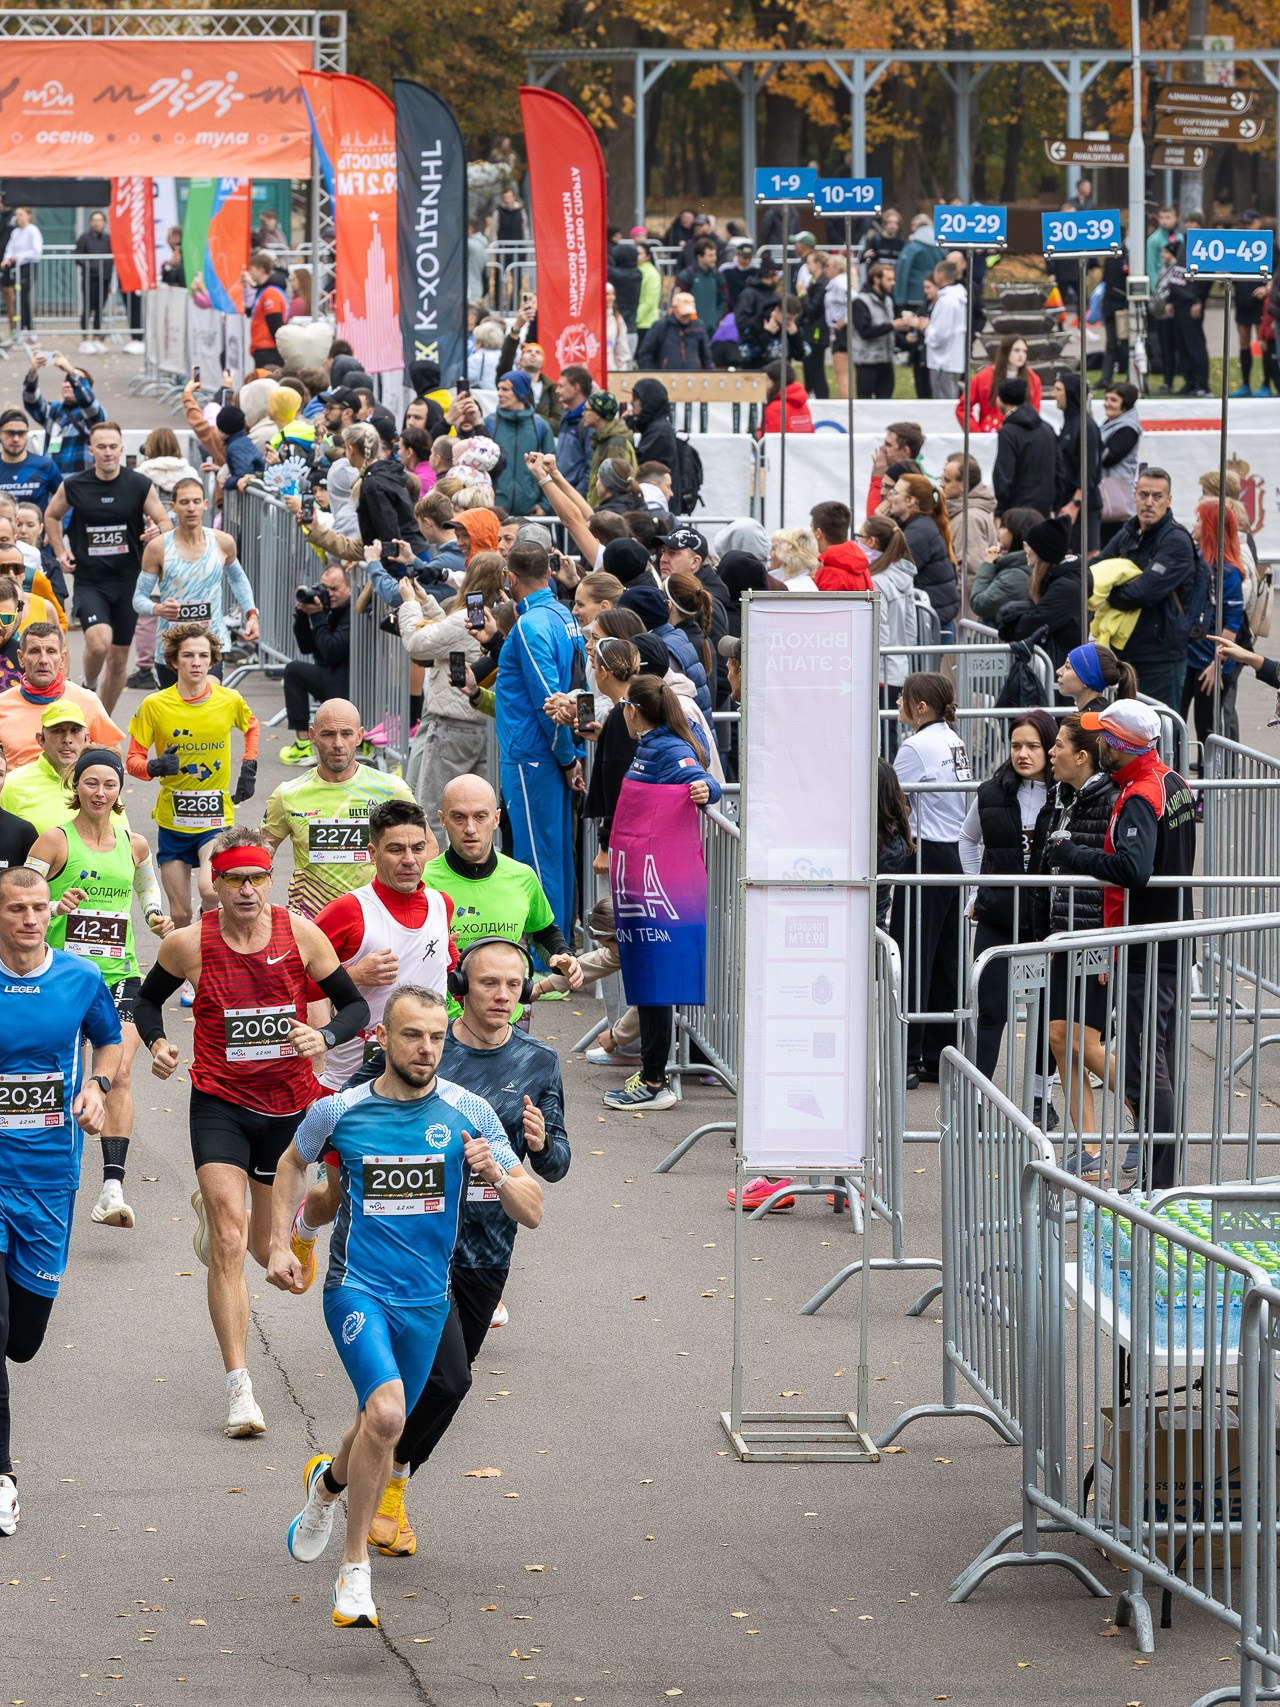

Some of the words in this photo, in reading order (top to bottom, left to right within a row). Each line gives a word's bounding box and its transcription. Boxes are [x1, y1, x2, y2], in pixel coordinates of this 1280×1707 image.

[35, 129, 95, 144] осень
[194, 131, 249, 148] тула
[771, 174, 801, 191] 1-9
[821, 185, 875, 203] 10-19
[940, 213, 1001, 234] 20-29
[1048, 219, 1114, 242] 30-39
[1192, 239, 1268, 262] 40-49
[91, 533, 124, 545] 2145
[179, 602, 208, 618] 028
[177, 796, 220, 812] 2268
[349, 808, 370, 817] ULTR
[316, 828, 363, 846] 2274
[72, 886, 131, 898] ХОЛДИНГ
[607, 847, 680, 920] LA
[74, 920, 120, 939] 42-1
[449, 922, 519, 935] К-ХОЛДИНГ
[635, 927, 672, 943] TEAM
[4, 985, 41, 994] LEGEA
[231, 1016, 292, 1039] 2060
[372, 1168, 437, 1189] 2001
